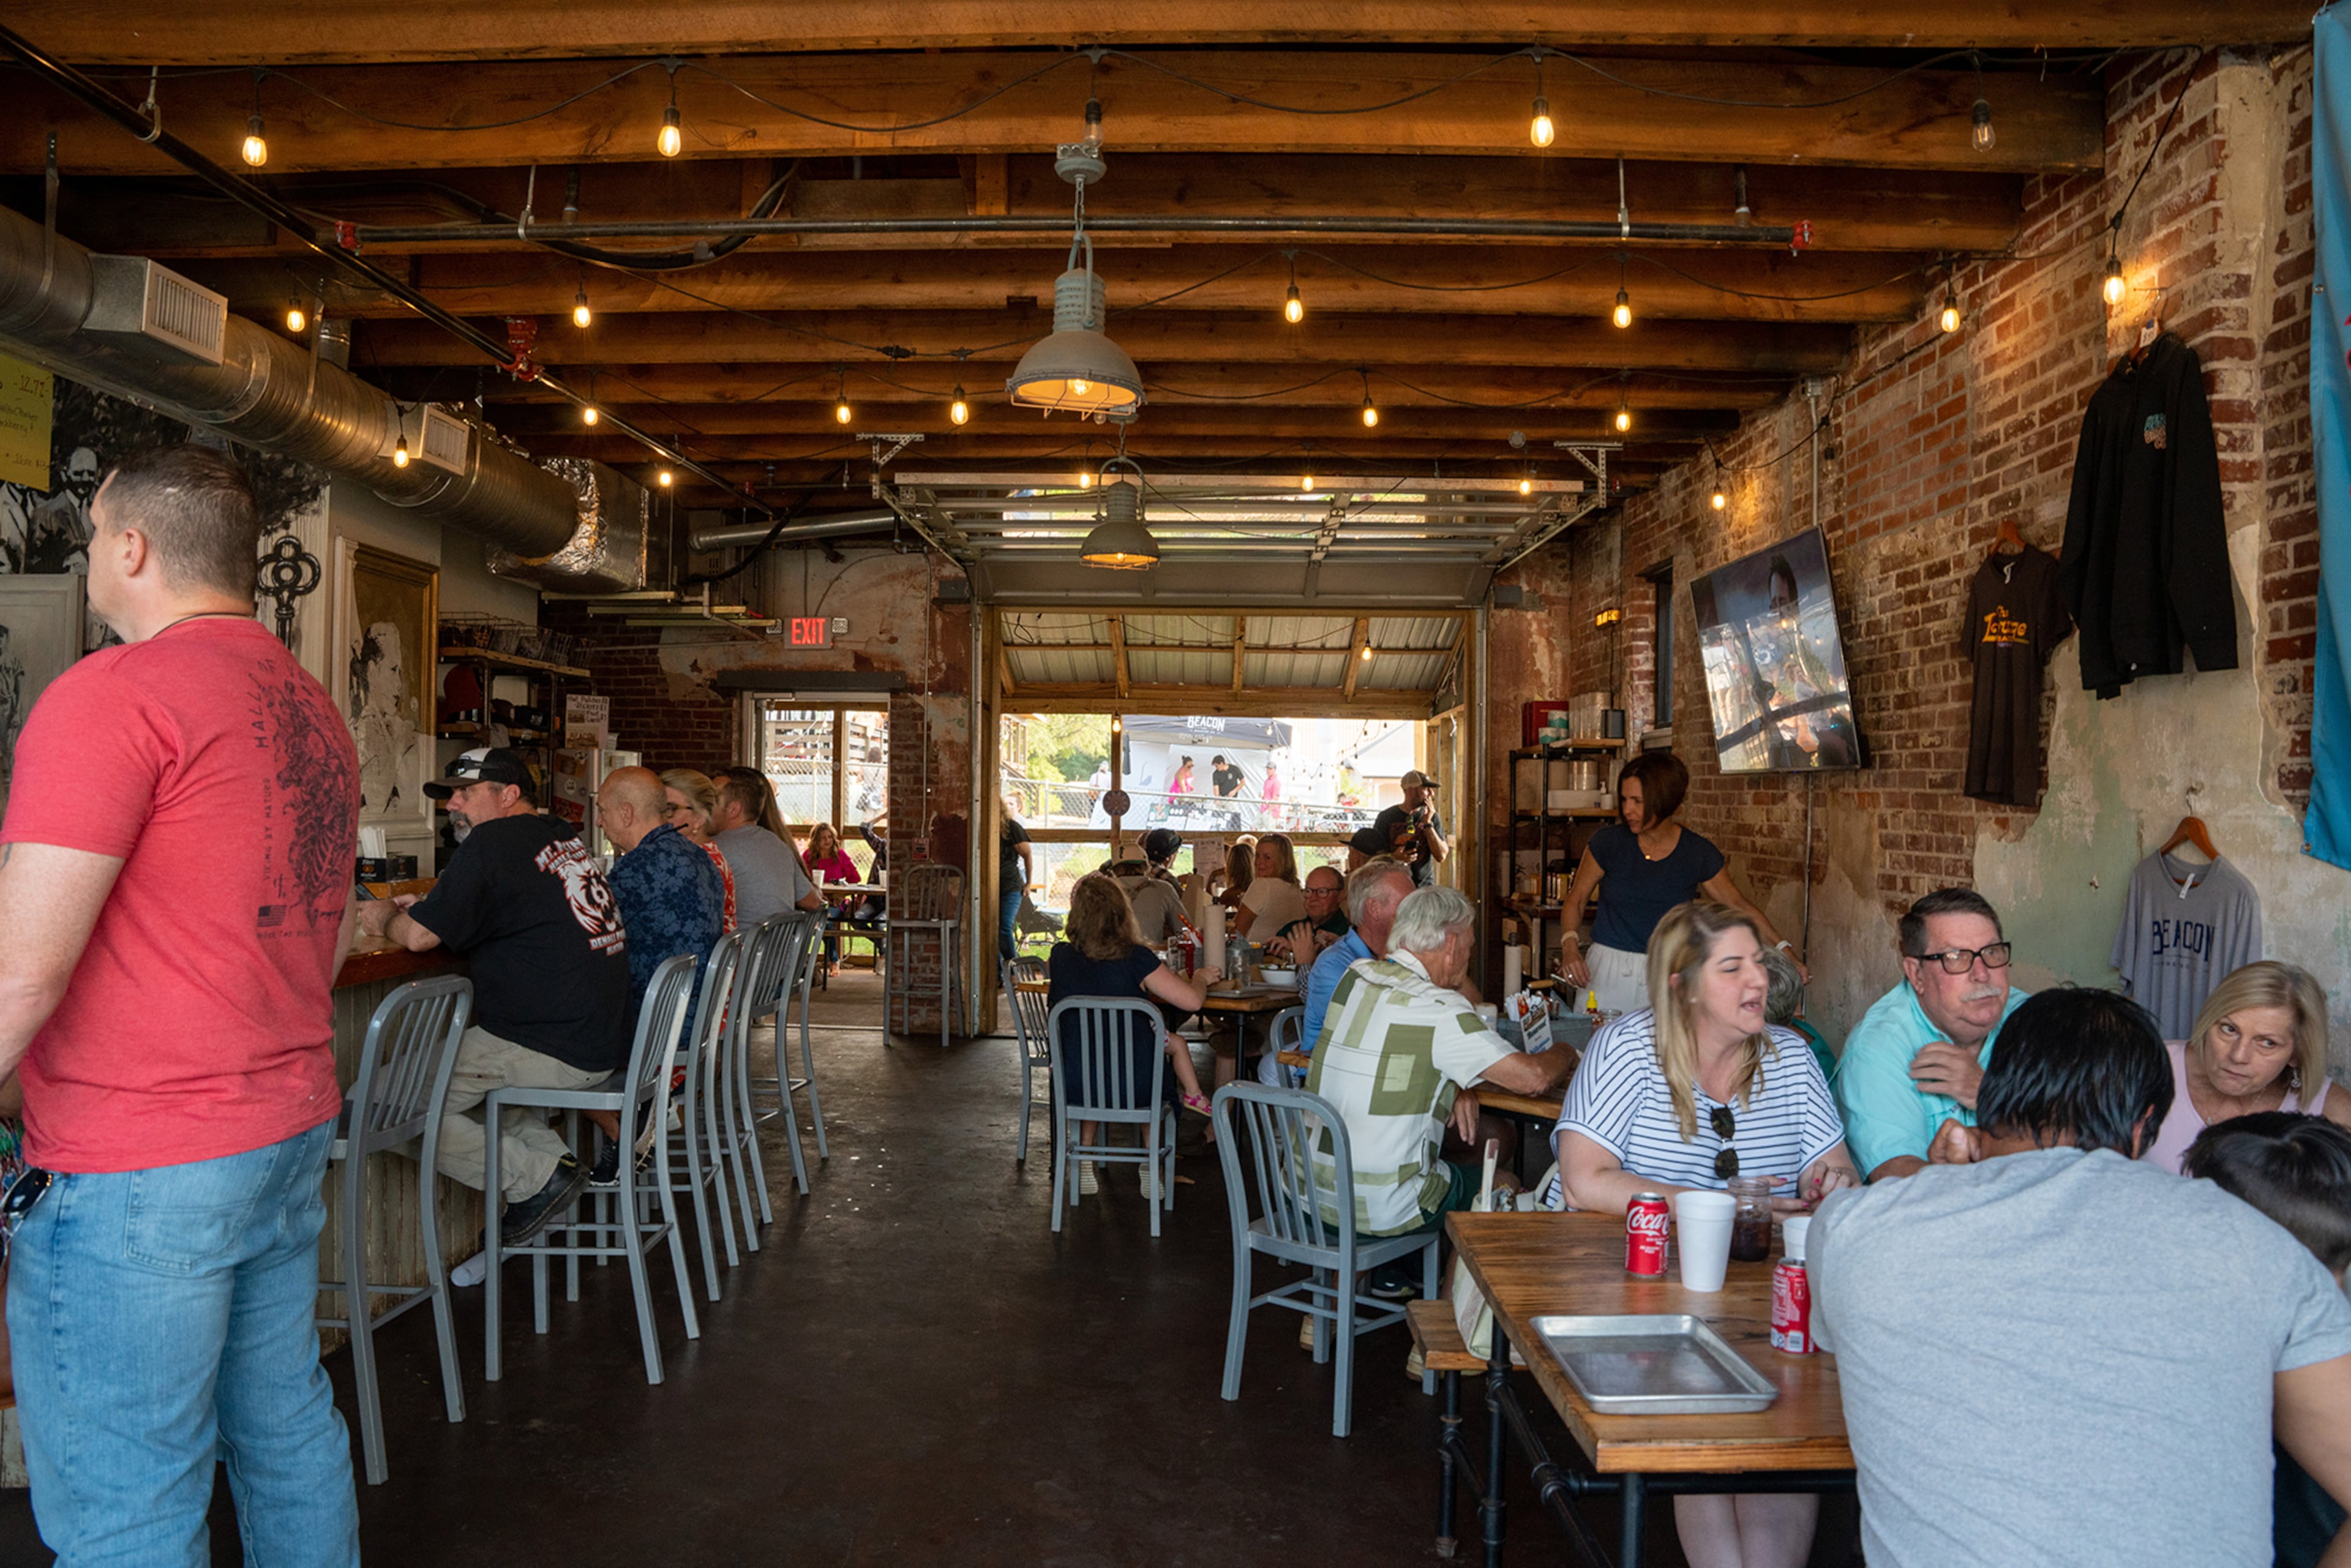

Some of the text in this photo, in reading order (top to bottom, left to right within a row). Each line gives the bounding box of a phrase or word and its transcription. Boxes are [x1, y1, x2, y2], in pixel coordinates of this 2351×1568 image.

[792, 618, 826, 645] EXIT
[1188, 716, 1225, 732] BEACON
[2152, 919, 2215, 962] BEACON
